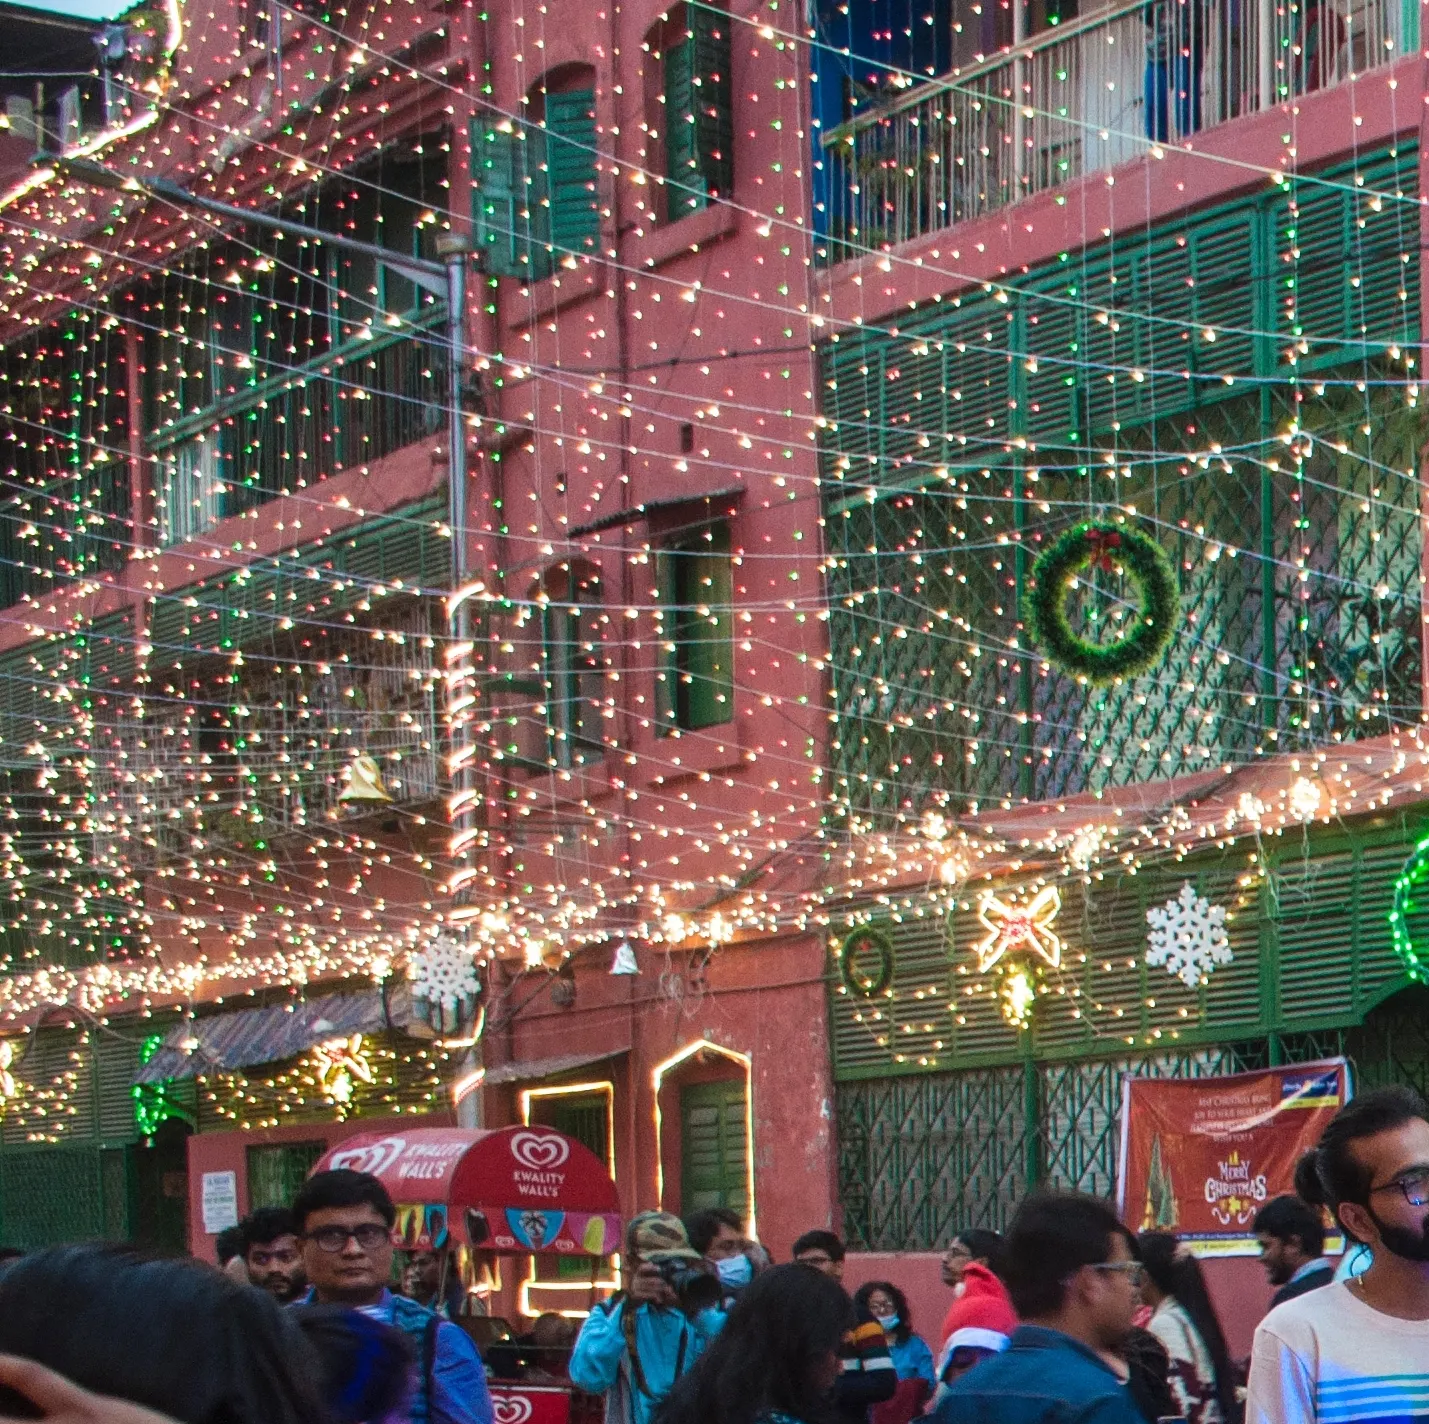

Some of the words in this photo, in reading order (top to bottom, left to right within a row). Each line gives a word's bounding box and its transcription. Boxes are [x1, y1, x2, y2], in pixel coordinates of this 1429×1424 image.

[399, 1160, 448, 1179] WALL'S
[513, 1170, 566, 1184] KWALITY
[518, 1183, 560, 1198] WALL'S
[1204, 1174, 1267, 1203] CHRISTMAS
